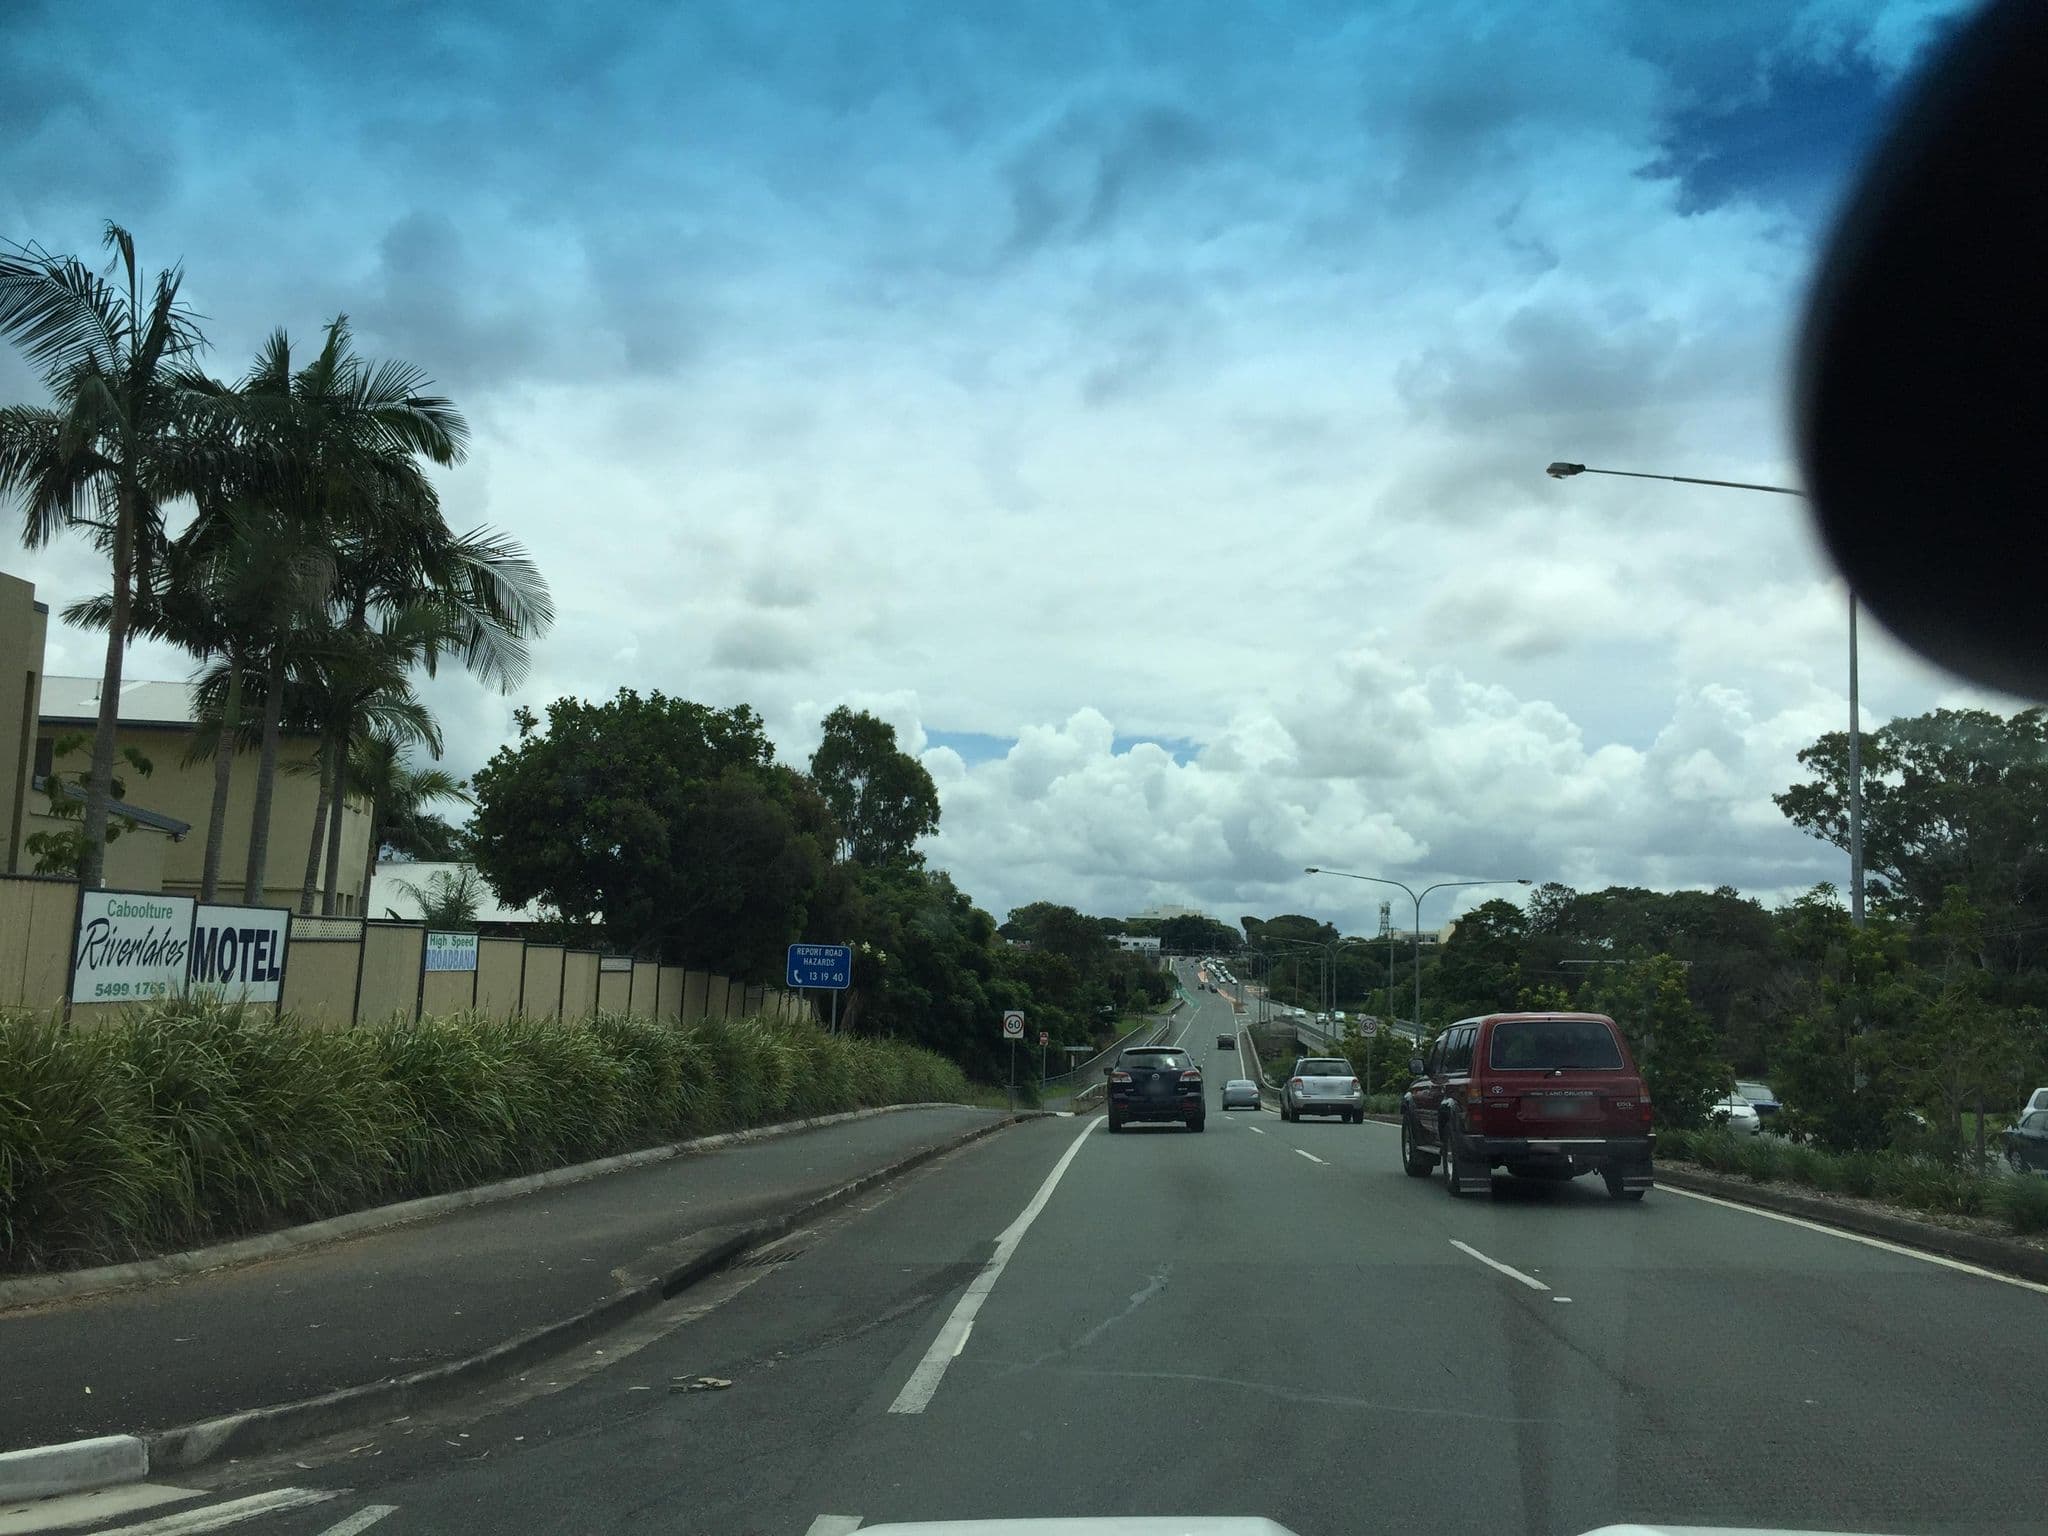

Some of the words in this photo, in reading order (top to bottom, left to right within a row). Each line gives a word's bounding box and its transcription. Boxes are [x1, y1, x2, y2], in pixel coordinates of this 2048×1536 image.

[107, 899, 173, 919] Caboolture
[77, 917, 188, 970] Riverlakes
[430, 934, 447, 948] High
[451, 935, 474, 948] Speed
[192, 927, 281, 984] MOTEL
[426, 949, 475, 969] BROADBAND
[796, 947, 822, 956] REPORT
[824, 949, 843, 957] ROAD
[803, 957, 836, 966] HAZARDS
[809, 972, 818, 981] 13
[821, 972, 829, 981] 19
[832, 973, 844, 982] 40
[94, 982, 130, 997] 5499
[1008, 1020, 1020, 1029] 60
[1363, 1022, 1375, 1030] 60
